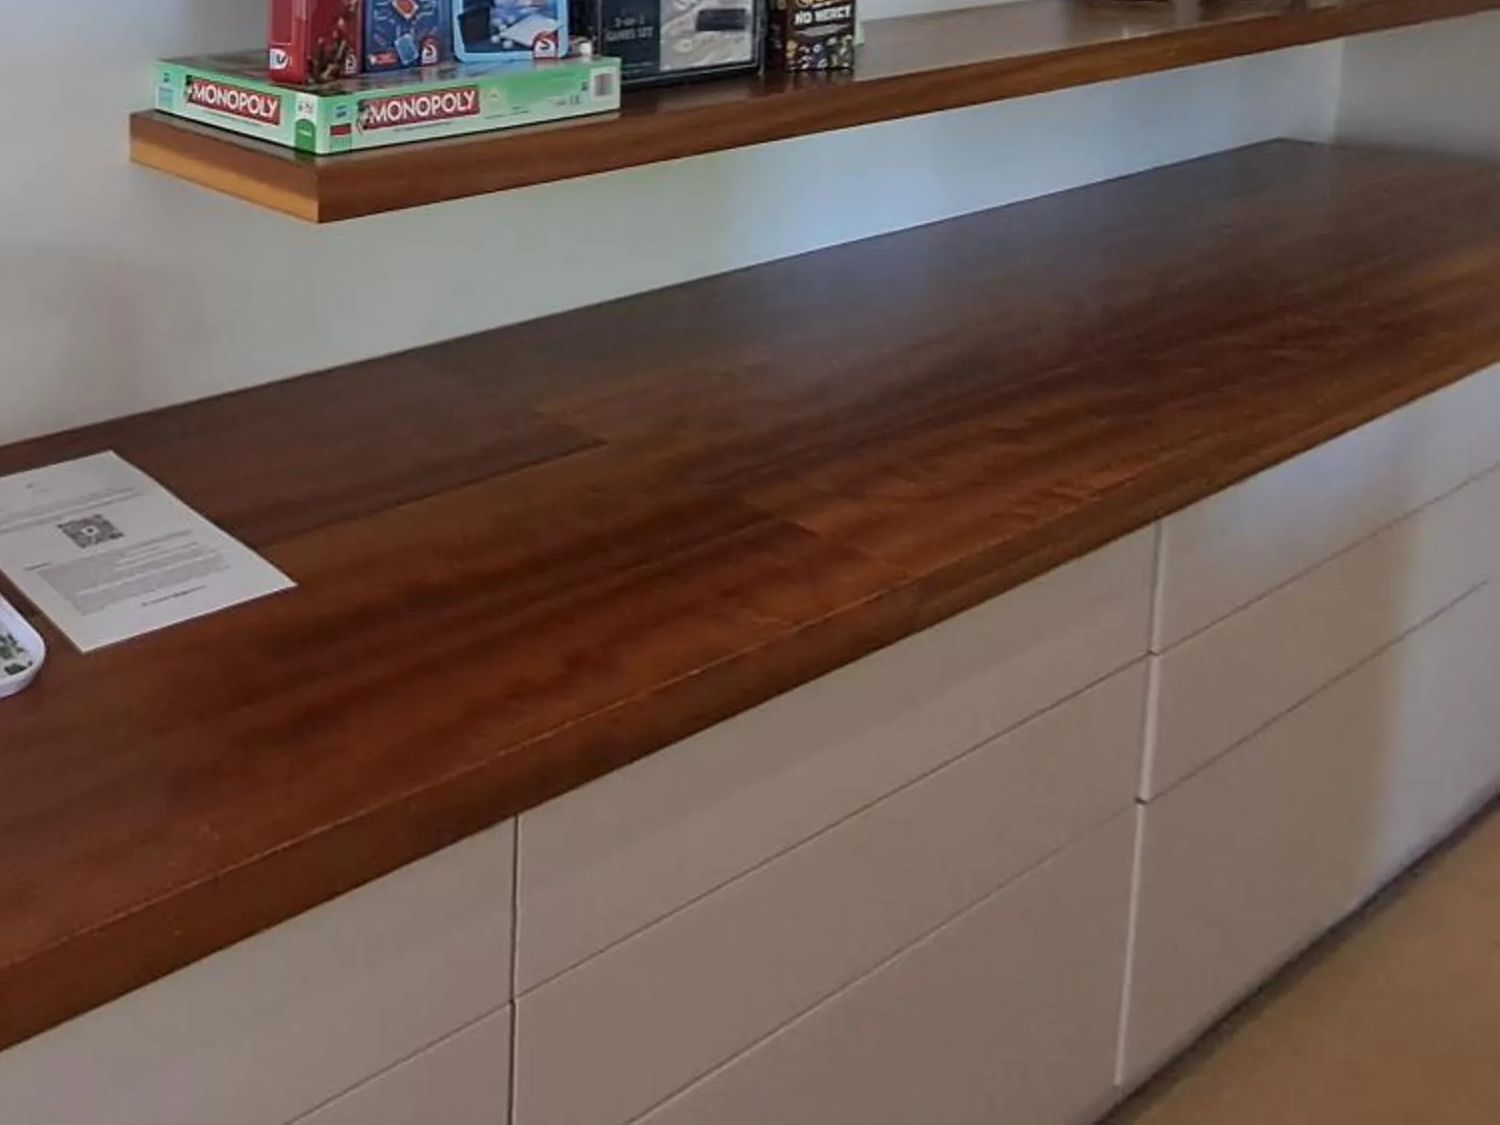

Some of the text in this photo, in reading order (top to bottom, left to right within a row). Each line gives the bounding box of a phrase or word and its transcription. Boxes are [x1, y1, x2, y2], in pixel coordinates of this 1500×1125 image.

[794, 10, 813, 25] NO
[192, 82, 279, 118] MONOPOLY
[368, 90, 477, 124] MONOPOLY
